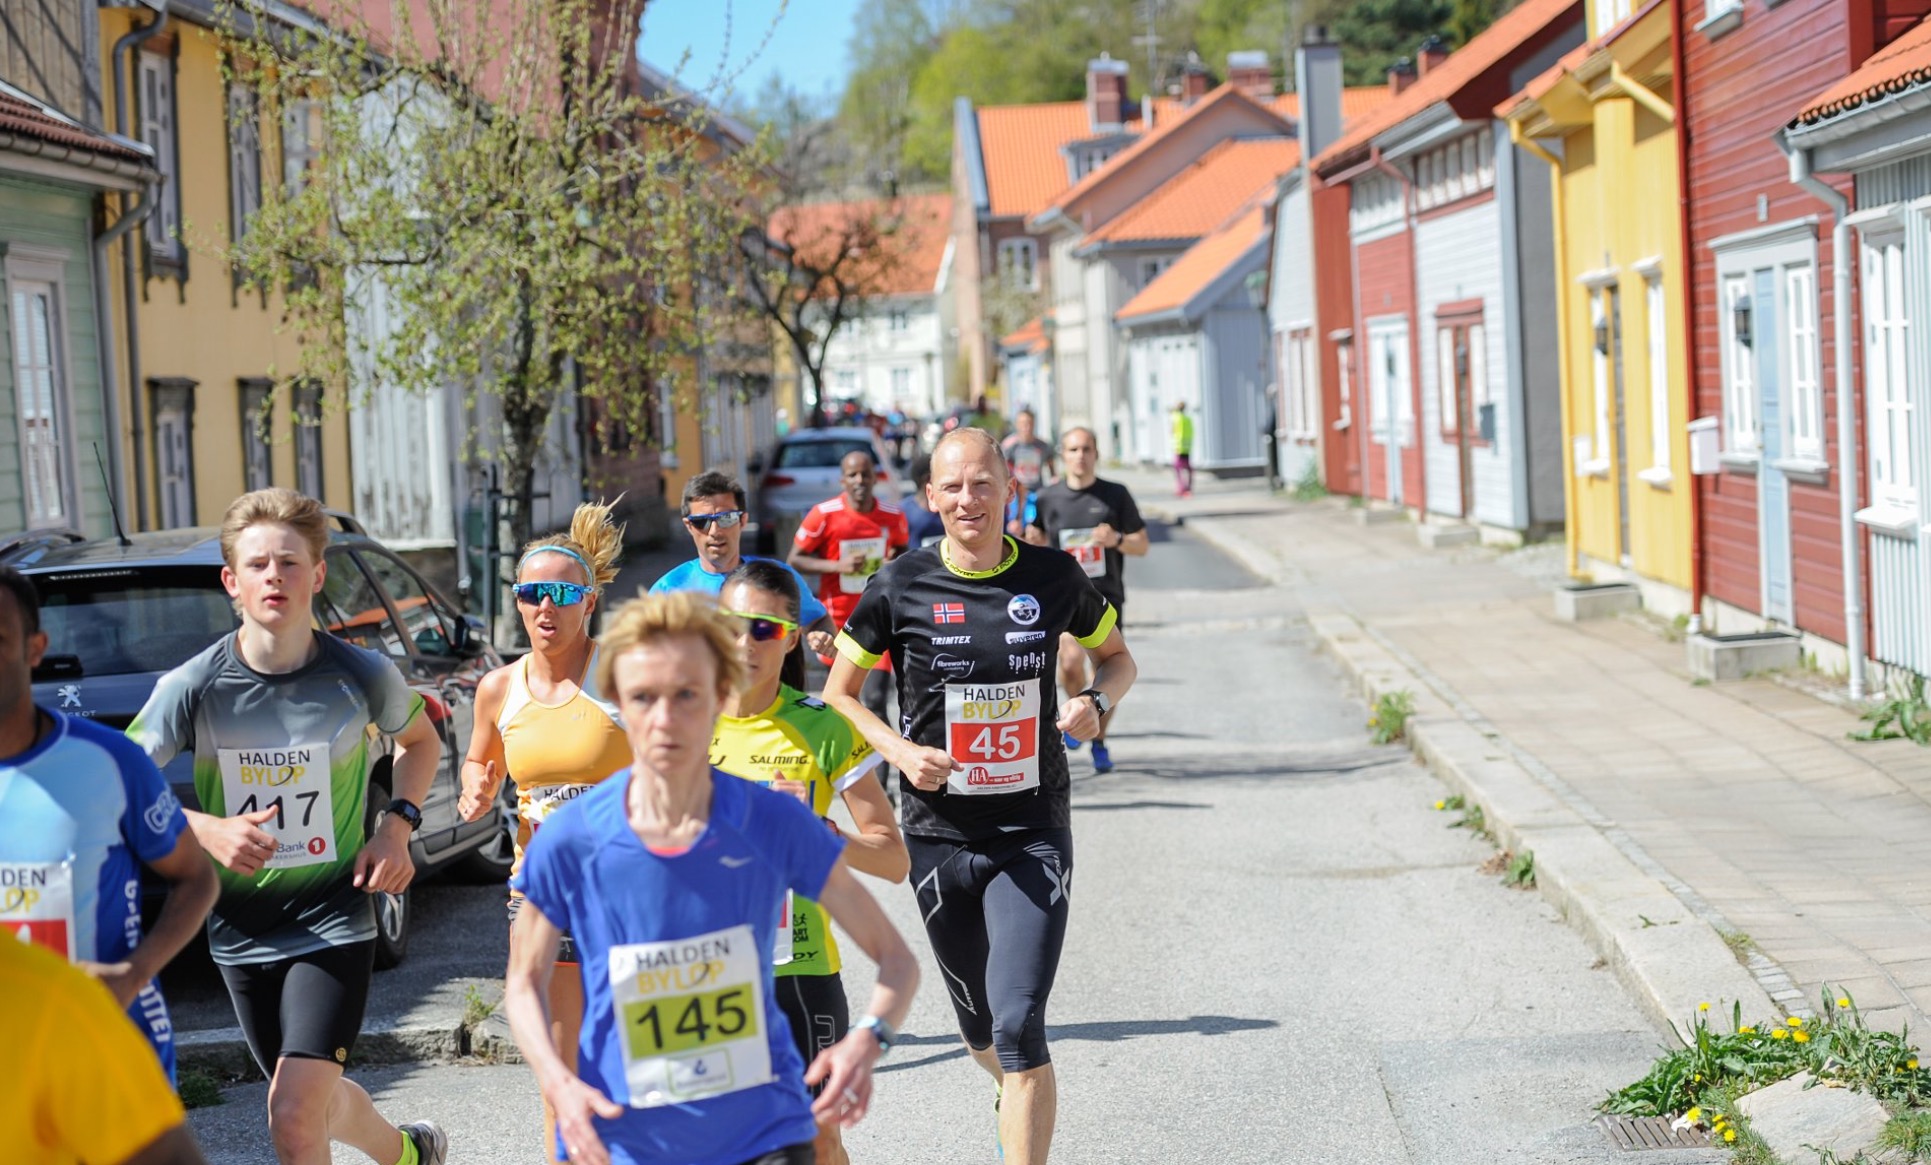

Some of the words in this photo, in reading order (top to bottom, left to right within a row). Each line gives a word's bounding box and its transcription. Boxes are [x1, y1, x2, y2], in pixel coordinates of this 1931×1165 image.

[931, 635, 972, 645] TRIMTEX
[963, 684, 1026, 701] HALDEN
[238, 749, 311, 767] HALDEN
[969, 725, 1021, 760] 45
[236, 790, 320, 830] 417
[635, 937, 731, 971] HALDEN
[637, 990, 747, 1050] 145
